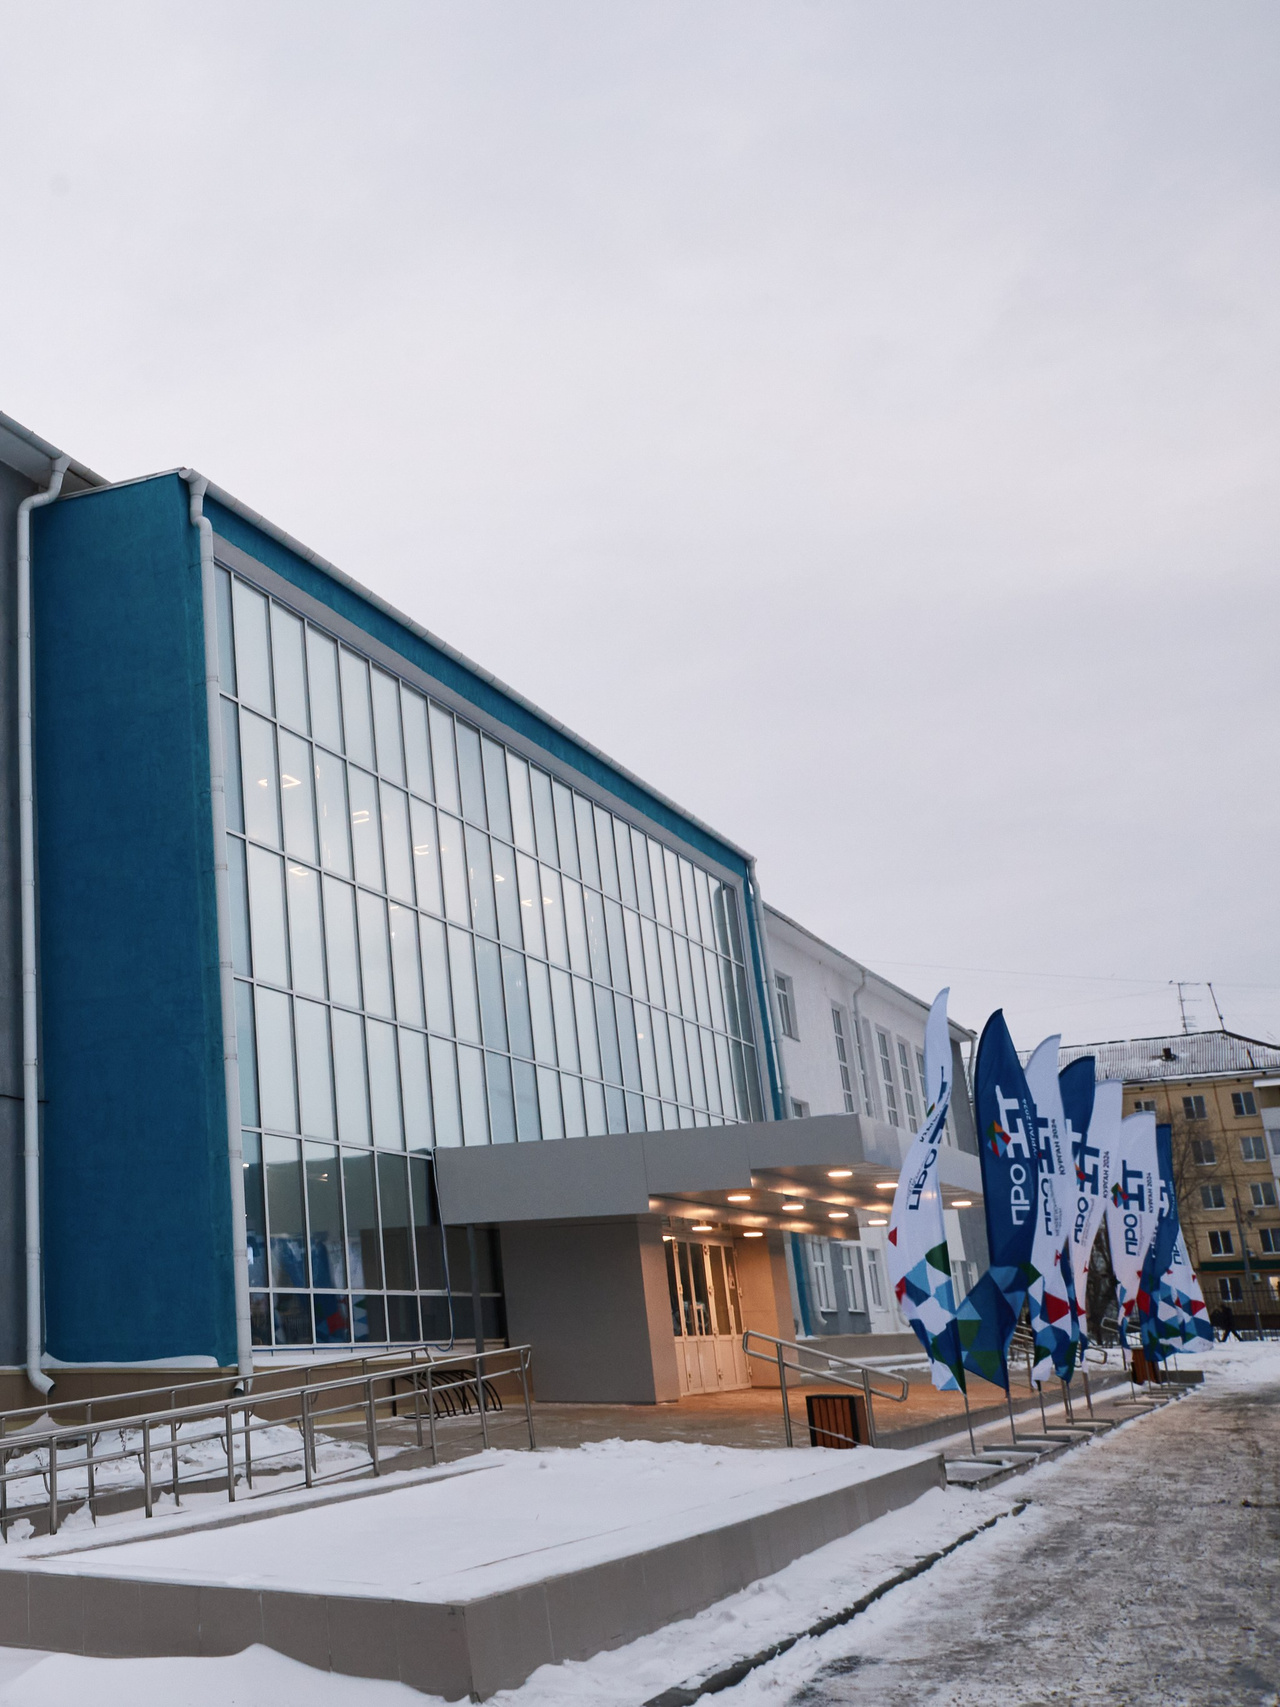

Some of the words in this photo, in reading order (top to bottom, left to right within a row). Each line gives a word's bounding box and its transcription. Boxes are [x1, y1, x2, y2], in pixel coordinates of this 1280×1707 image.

[1051, 1118, 1060, 1140] 2024
[1054, 1141, 1066, 1176] КУРГАН
[1102, 1150, 1110, 1169] 2024
[1009, 1163, 1031, 1226] ПРО
[1102, 1169, 1110, 1199] КУРГАН
[1123, 1213, 1138, 1256] ПРО
